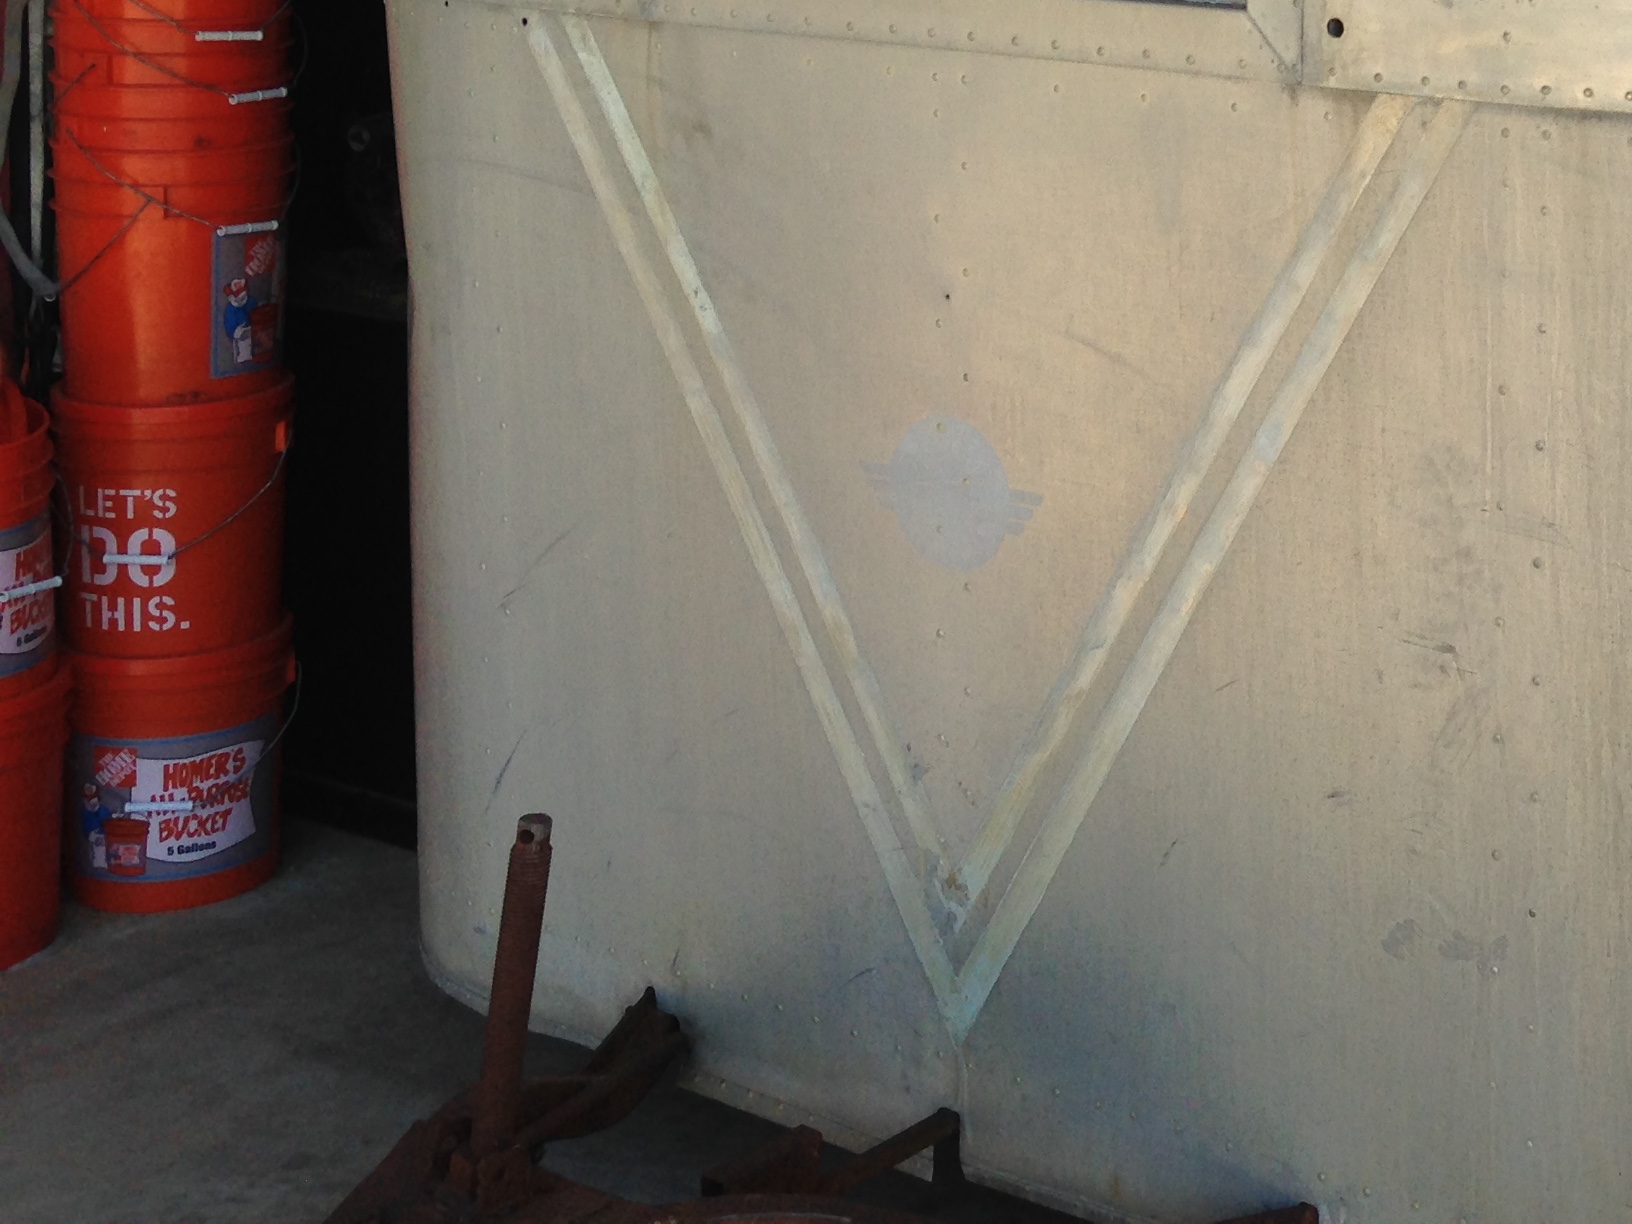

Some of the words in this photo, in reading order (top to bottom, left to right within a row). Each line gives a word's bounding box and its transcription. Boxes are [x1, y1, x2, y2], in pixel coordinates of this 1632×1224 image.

[80, 486, 177, 519] LET'S
[80, 525, 177, 588] DO
[81, 592, 190, 632] THIS.
[162, 747, 247, 792] HOMER'S
[159, 807, 234, 843] BUCKET
[167, 846, 175, 856] 5
[177, 840, 217, 856] Gallons
